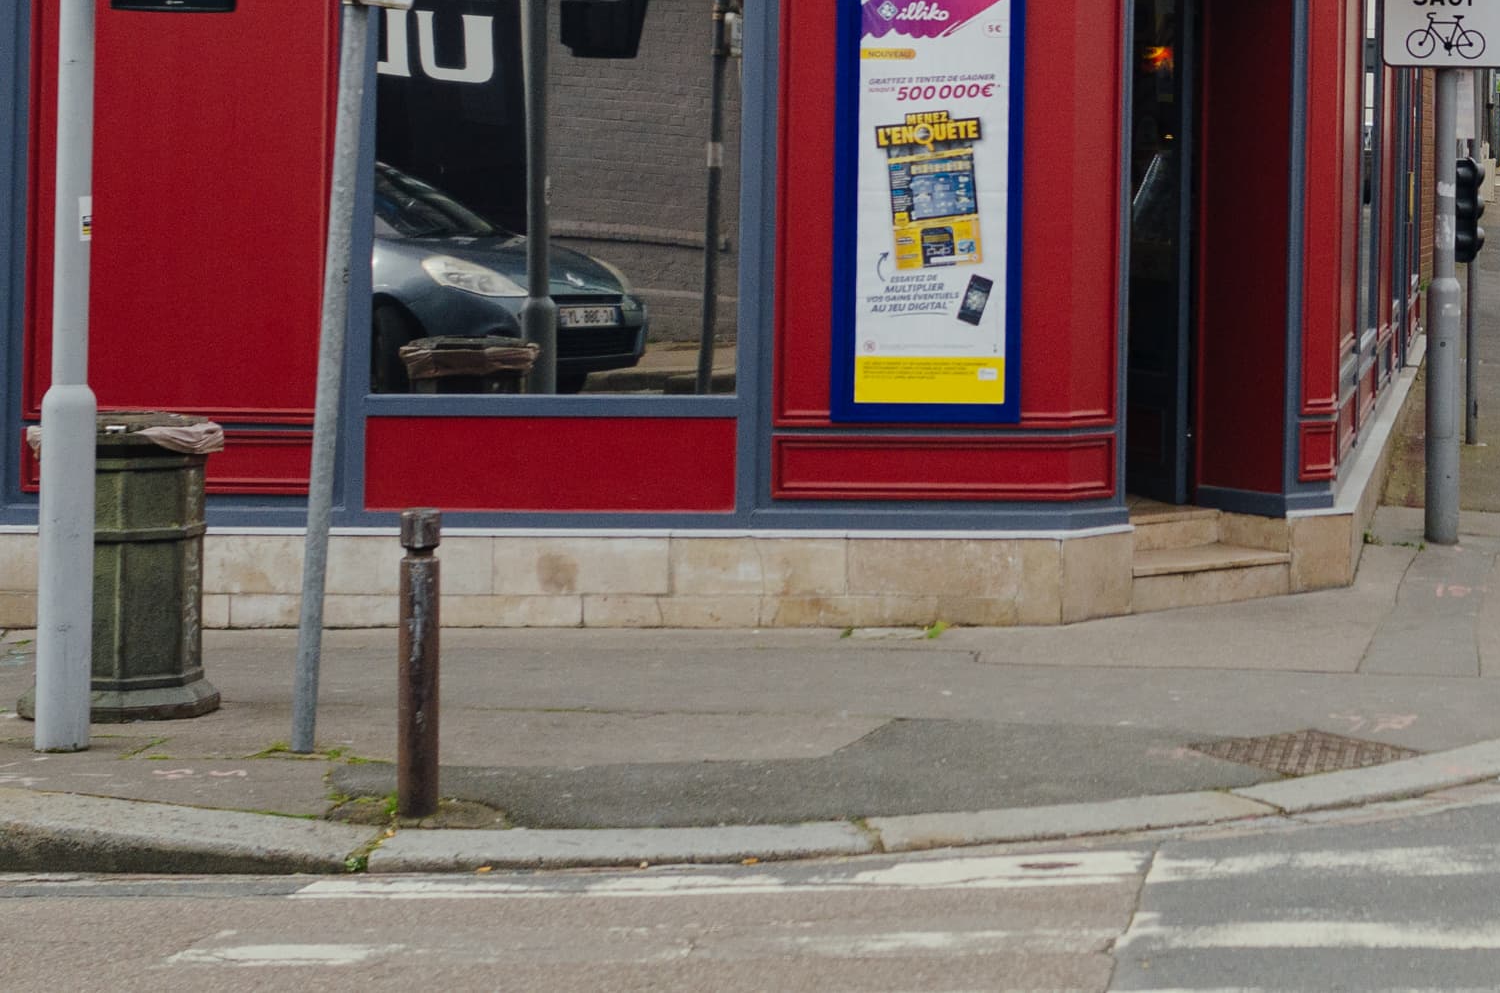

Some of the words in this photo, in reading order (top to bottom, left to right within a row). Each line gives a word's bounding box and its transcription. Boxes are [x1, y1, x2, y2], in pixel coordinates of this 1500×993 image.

[896, 1, 949, 21] illiko
[867, 50, 912, 59] NOUVEAU
[868, 77, 906, 85] GRATTEZ
[915, 76, 945, 84] TENTEZ
[959, 73, 996, 81] GAGNER
[896, 85, 936, 101] 500
[906, 111, 948, 124] MENEZ
[890, 275, 925, 283] ESSAYEZ
[884, 283, 944, 293] MULTIPLIER
[866, 295, 883, 303] VOS
[885, 294, 911, 302] GAINS
[912, 291, 959, 301] ÉVENTUELS
[871, 304, 886, 313] AU
[887, 303, 906, 312] JEU
